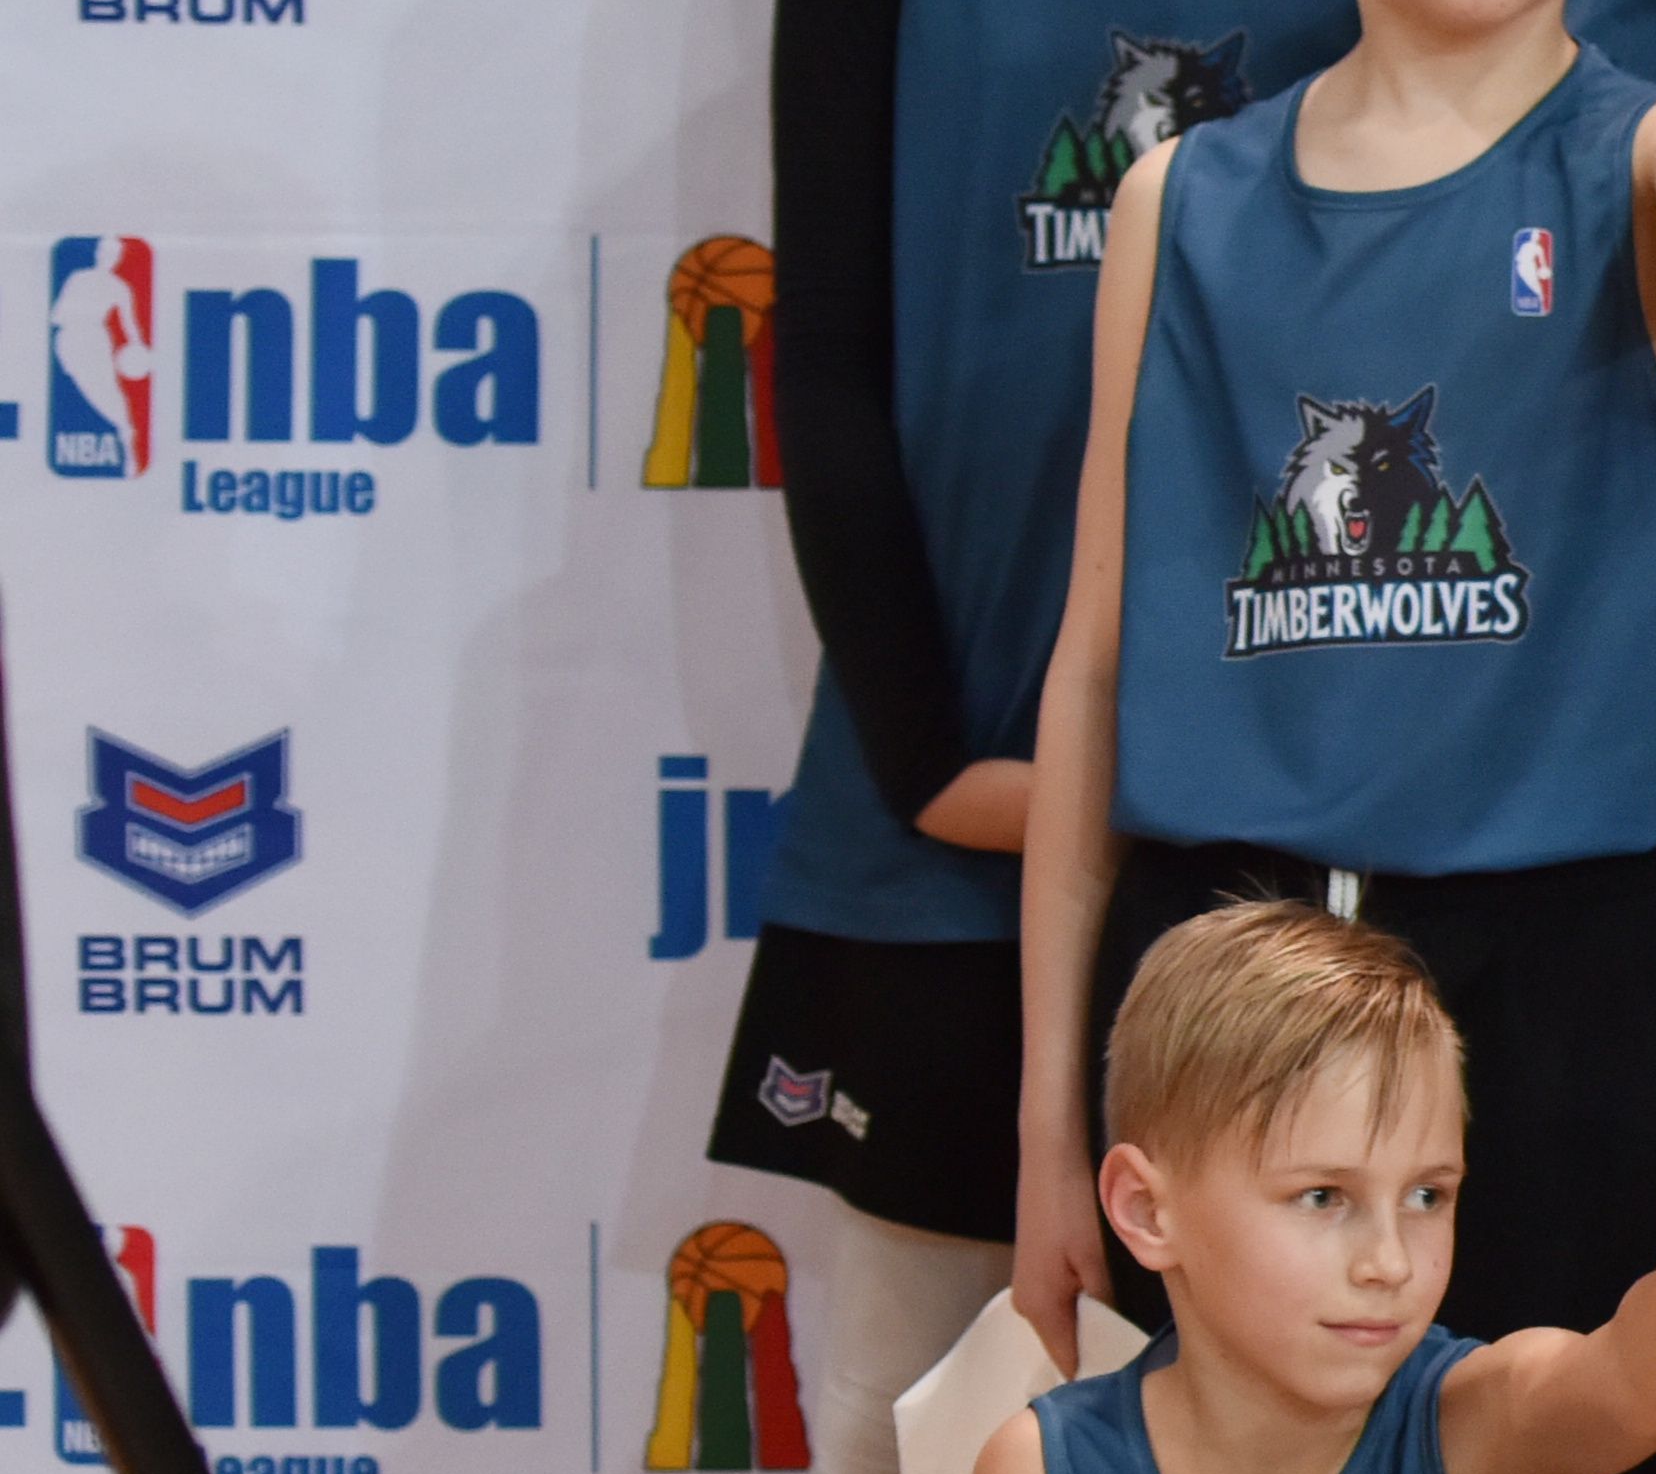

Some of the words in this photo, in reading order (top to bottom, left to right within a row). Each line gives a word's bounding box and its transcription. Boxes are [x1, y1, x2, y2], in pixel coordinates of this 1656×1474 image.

[183, 258, 539, 446] nba
[182, 460, 376, 520] League
[1272, 557, 1462, 583] MINNESOTA
[1232, 573, 1521, 652] TIMBERWOLVES
[78, 936, 304, 973] BRUM
[78, 978, 304, 1015] BRUM
[187, 1246, 541, 1431] nba
